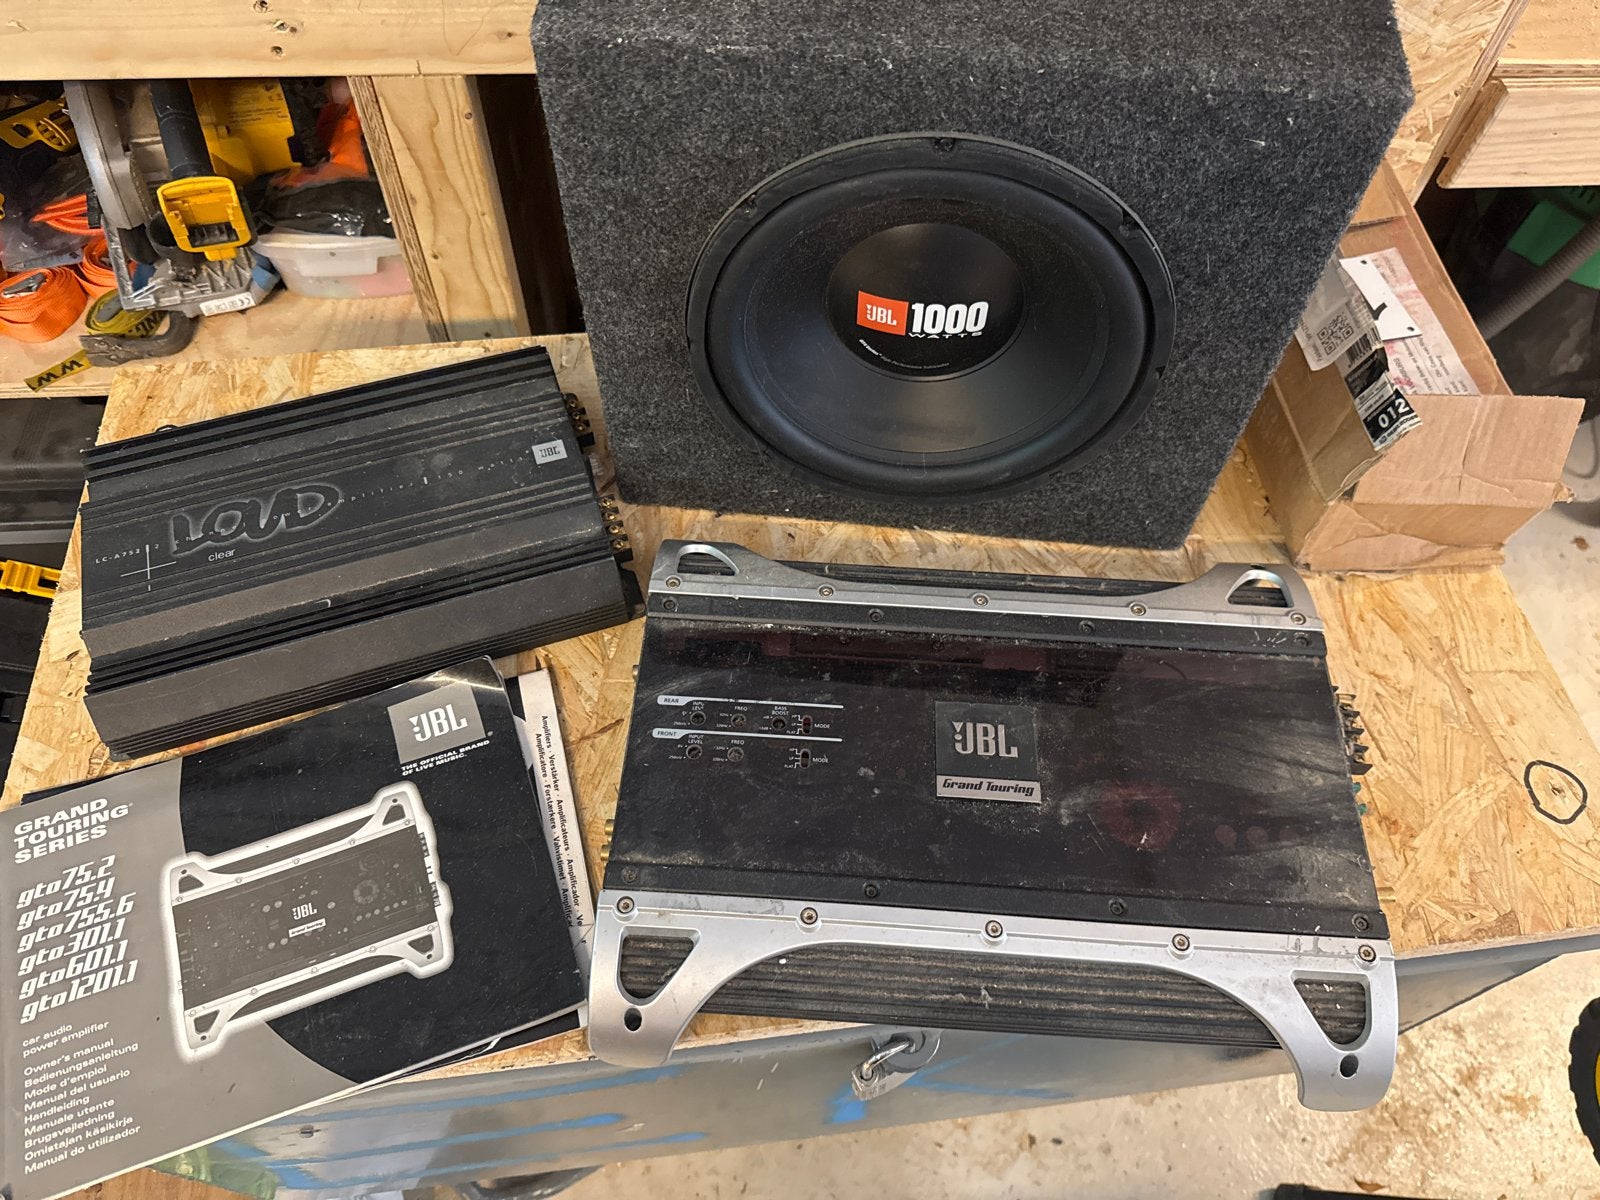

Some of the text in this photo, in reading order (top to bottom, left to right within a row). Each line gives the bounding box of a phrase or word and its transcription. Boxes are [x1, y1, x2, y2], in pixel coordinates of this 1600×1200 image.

[866, 303, 897, 326] JBL
[911, 301, 989, 334] 1000
[1378, 398, 1410, 429] 012
[539, 446, 561, 458] JBL
[208, 549, 236, 562] clear
[409, 704, 468, 742] JBL
[952, 721, 1018, 758] JBL
[401, 740, 490, 771] THE OFFICIAL BRAND
[402, 768, 413, 776] OF
[415, 762, 434, 772] LIVE
[535, 733, 548, 778] Amplificatore
[544, 784, 557, 830] Forstærkere
[553, 836, 566, 881] Vahvistimet
[942, 779, 1034, 797] Grand Touring
[14, 798, 108, 835] GRAND
[14, 804, 129, 850] TOURING
[542, 715, 580, 907] Amplifiers Verstärker Amplificateurs Amplificador
[14, 824, 108, 864] SERIES
[16, 854, 116, 909] gto75.2
[16, 876, 116, 932] gto75.4
[17, 892, 137, 954] gto755.6
[292, 902, 318, 920] JBL
[17, 917, 126, 977] gto301.1
[18, 939, 129, 1000] gto601.1
[20, 959, 139, 1025] gto1201.1
[22, 1024, 73, 1047] car audio
[23, 1021, 109, 1058] power amplifier
[24, 1038, 114, 1076] Owner's manual
[24, 1042, 139, 1088] Bedienungsanleitung
[24, 1064, 107, 1100] Mode d'emploi
[24, 1069, 131, 1112] Manual del usuario
[24, 1096, 90, 1124] Handleiding
[24, 1099, 115, 1136] Manuale utente
[24, 1111, 115, 1149] Brugsvejledning
[24, 1116, 134, 1161] Omistajan käsikirja
[24, 1126, 141, 1174] Manual do utilizador
